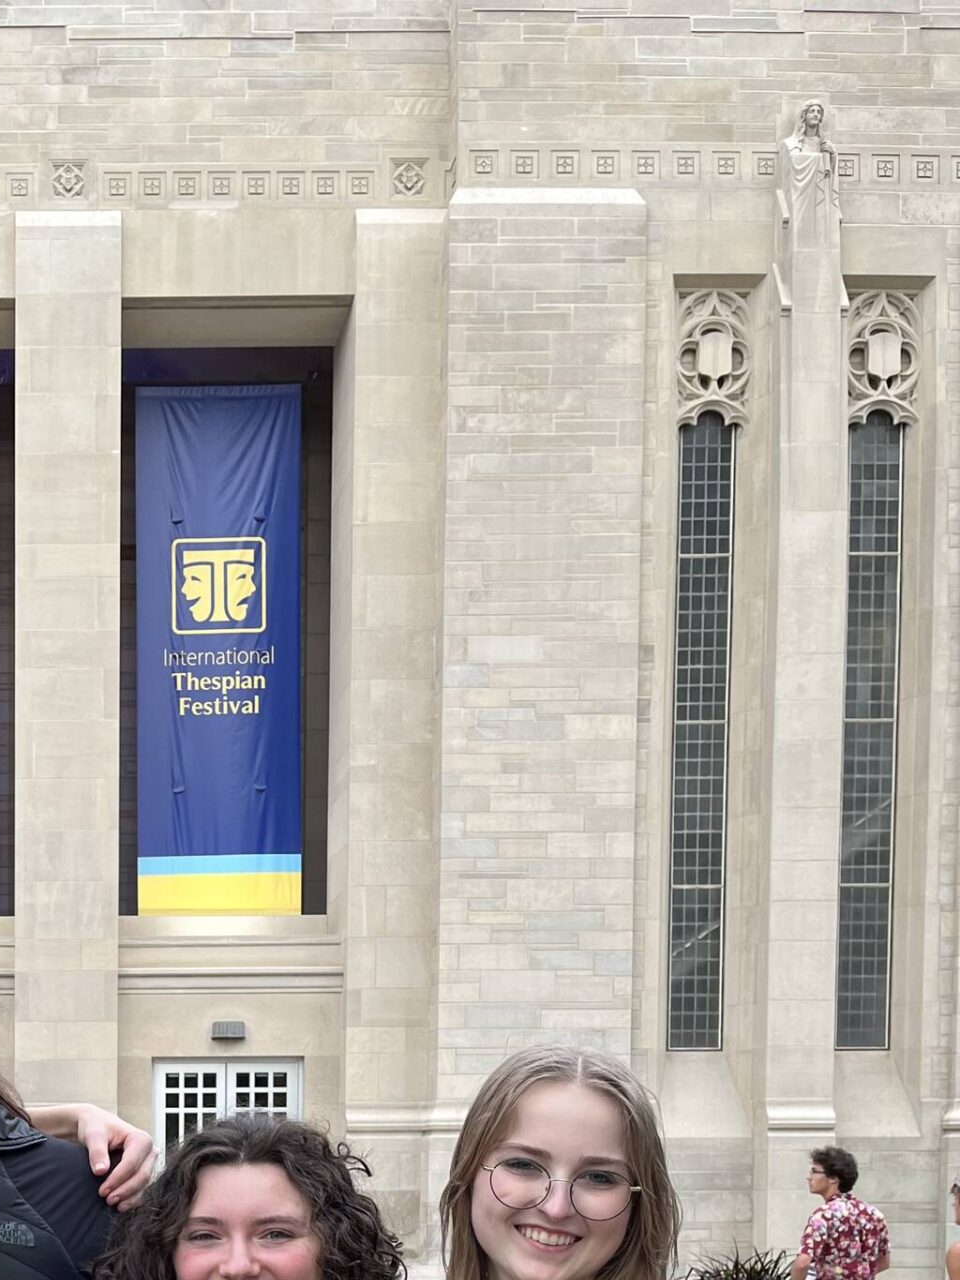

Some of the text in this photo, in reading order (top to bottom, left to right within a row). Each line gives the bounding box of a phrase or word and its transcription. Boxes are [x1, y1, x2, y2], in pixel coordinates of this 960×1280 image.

[163, 645, 275, 666] International
[172, 671, 266, 693] Thespian
[179, 695, 260, 716] Festival
[0, 1221, 18, 1230] THE
